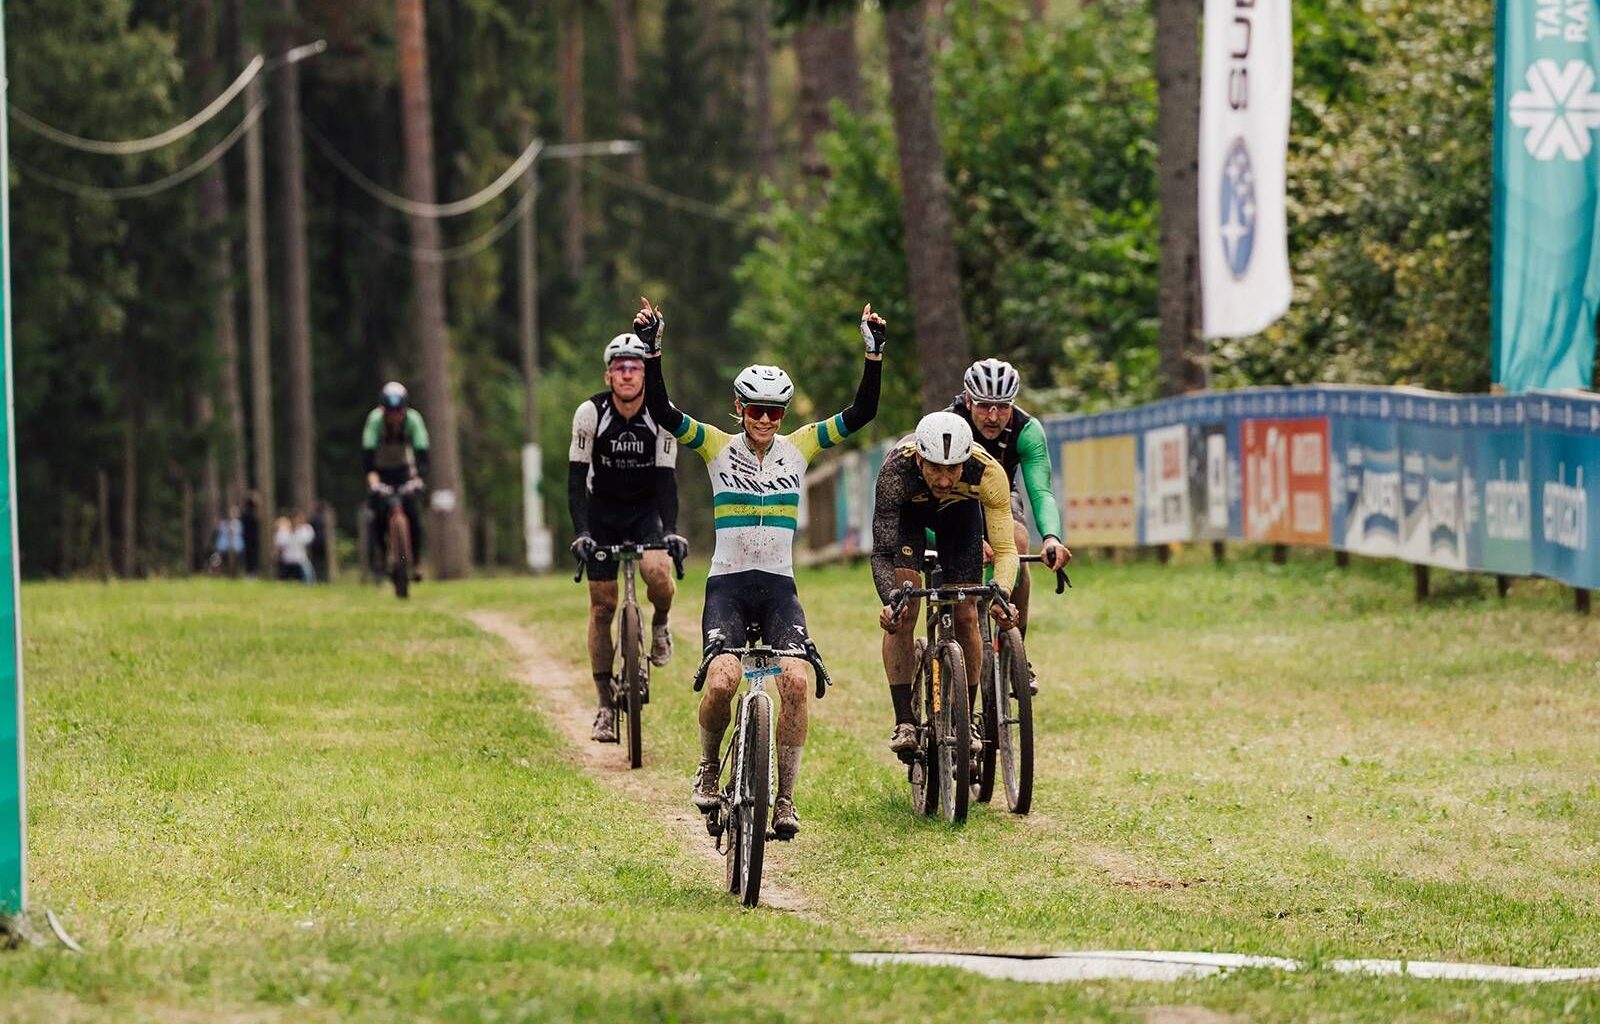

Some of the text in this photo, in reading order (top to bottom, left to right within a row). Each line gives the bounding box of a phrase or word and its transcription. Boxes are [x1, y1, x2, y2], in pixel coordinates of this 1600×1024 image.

[1535, 0, 1560, 41] TA
[1564, 0, 1588, 43] RA
[1228, 0, 1254, 111] SU
[610, 439, 644, 454] TARTU
[719, 471, 800, 494] CANYON
